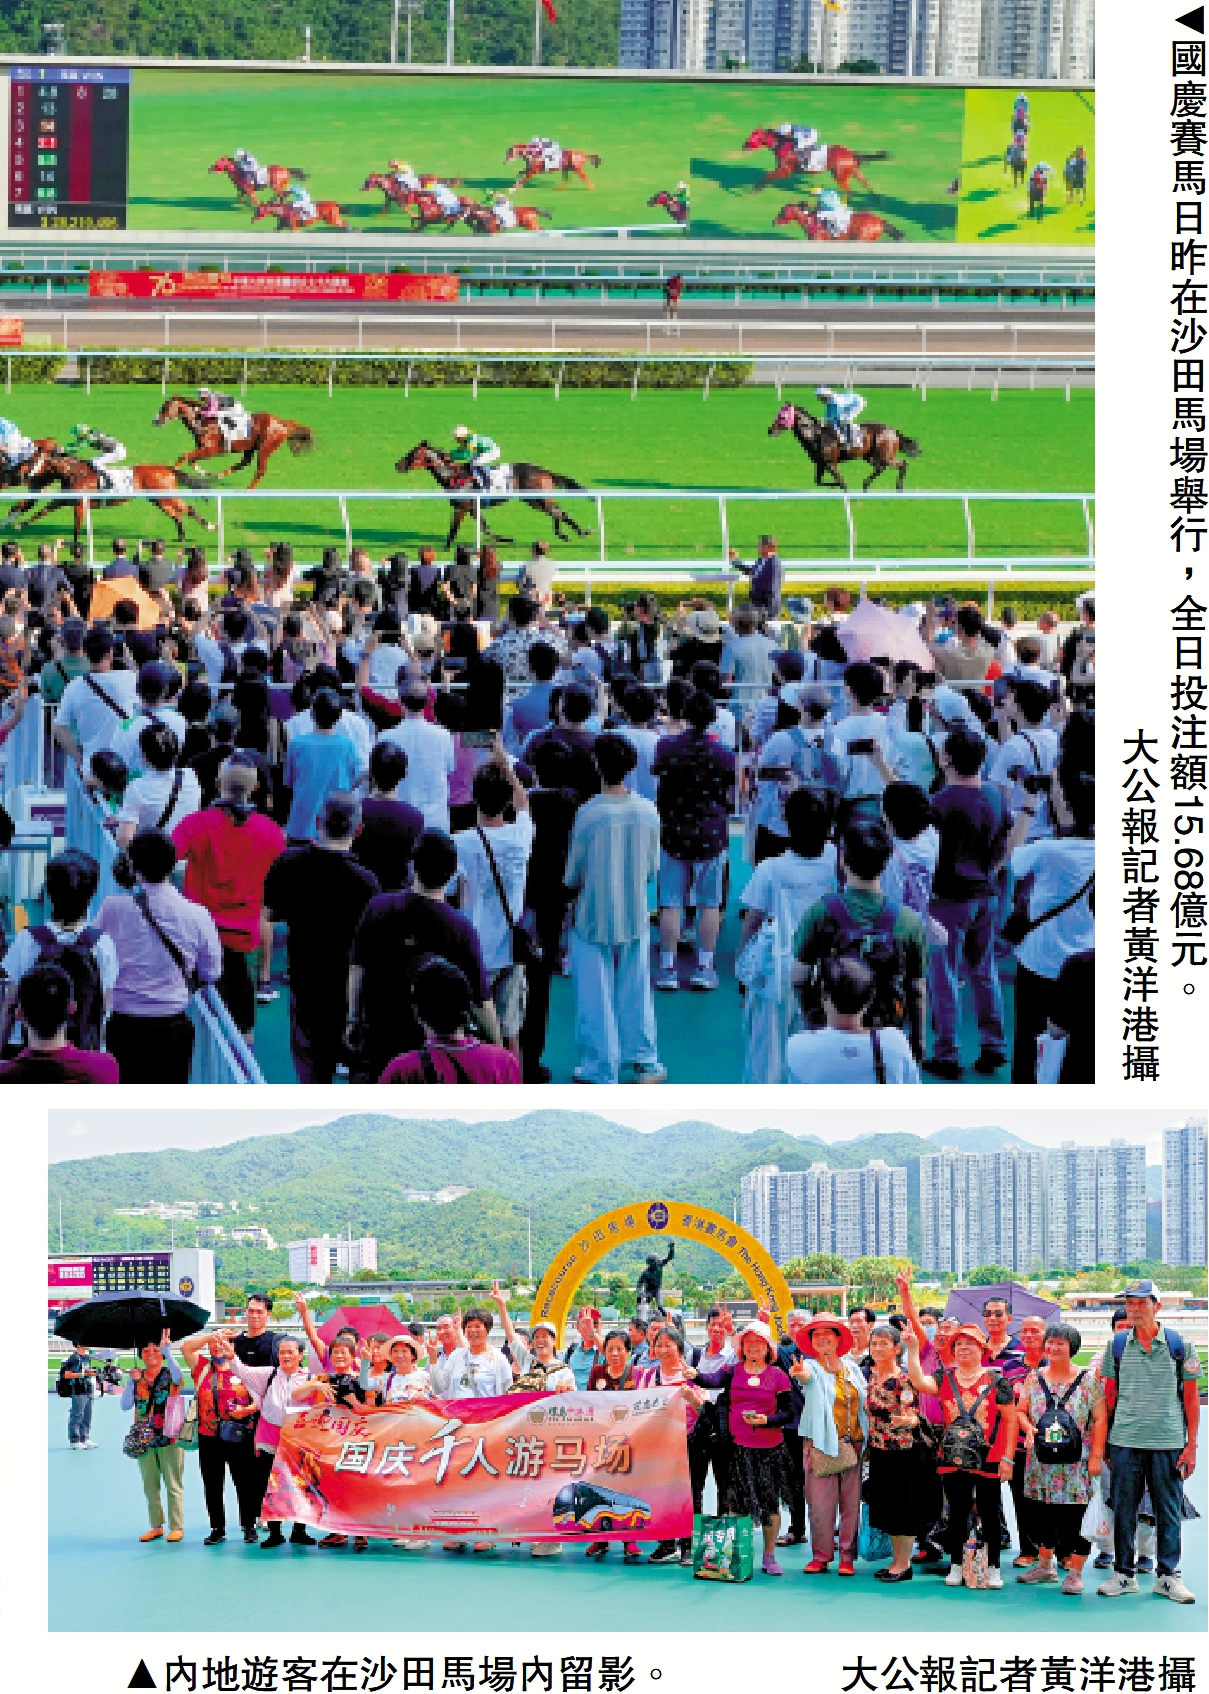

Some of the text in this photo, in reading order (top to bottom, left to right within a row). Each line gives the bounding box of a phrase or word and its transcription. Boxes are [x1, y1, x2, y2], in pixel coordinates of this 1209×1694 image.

[333, 1418, 634, 1486] 国庆千人游马场
